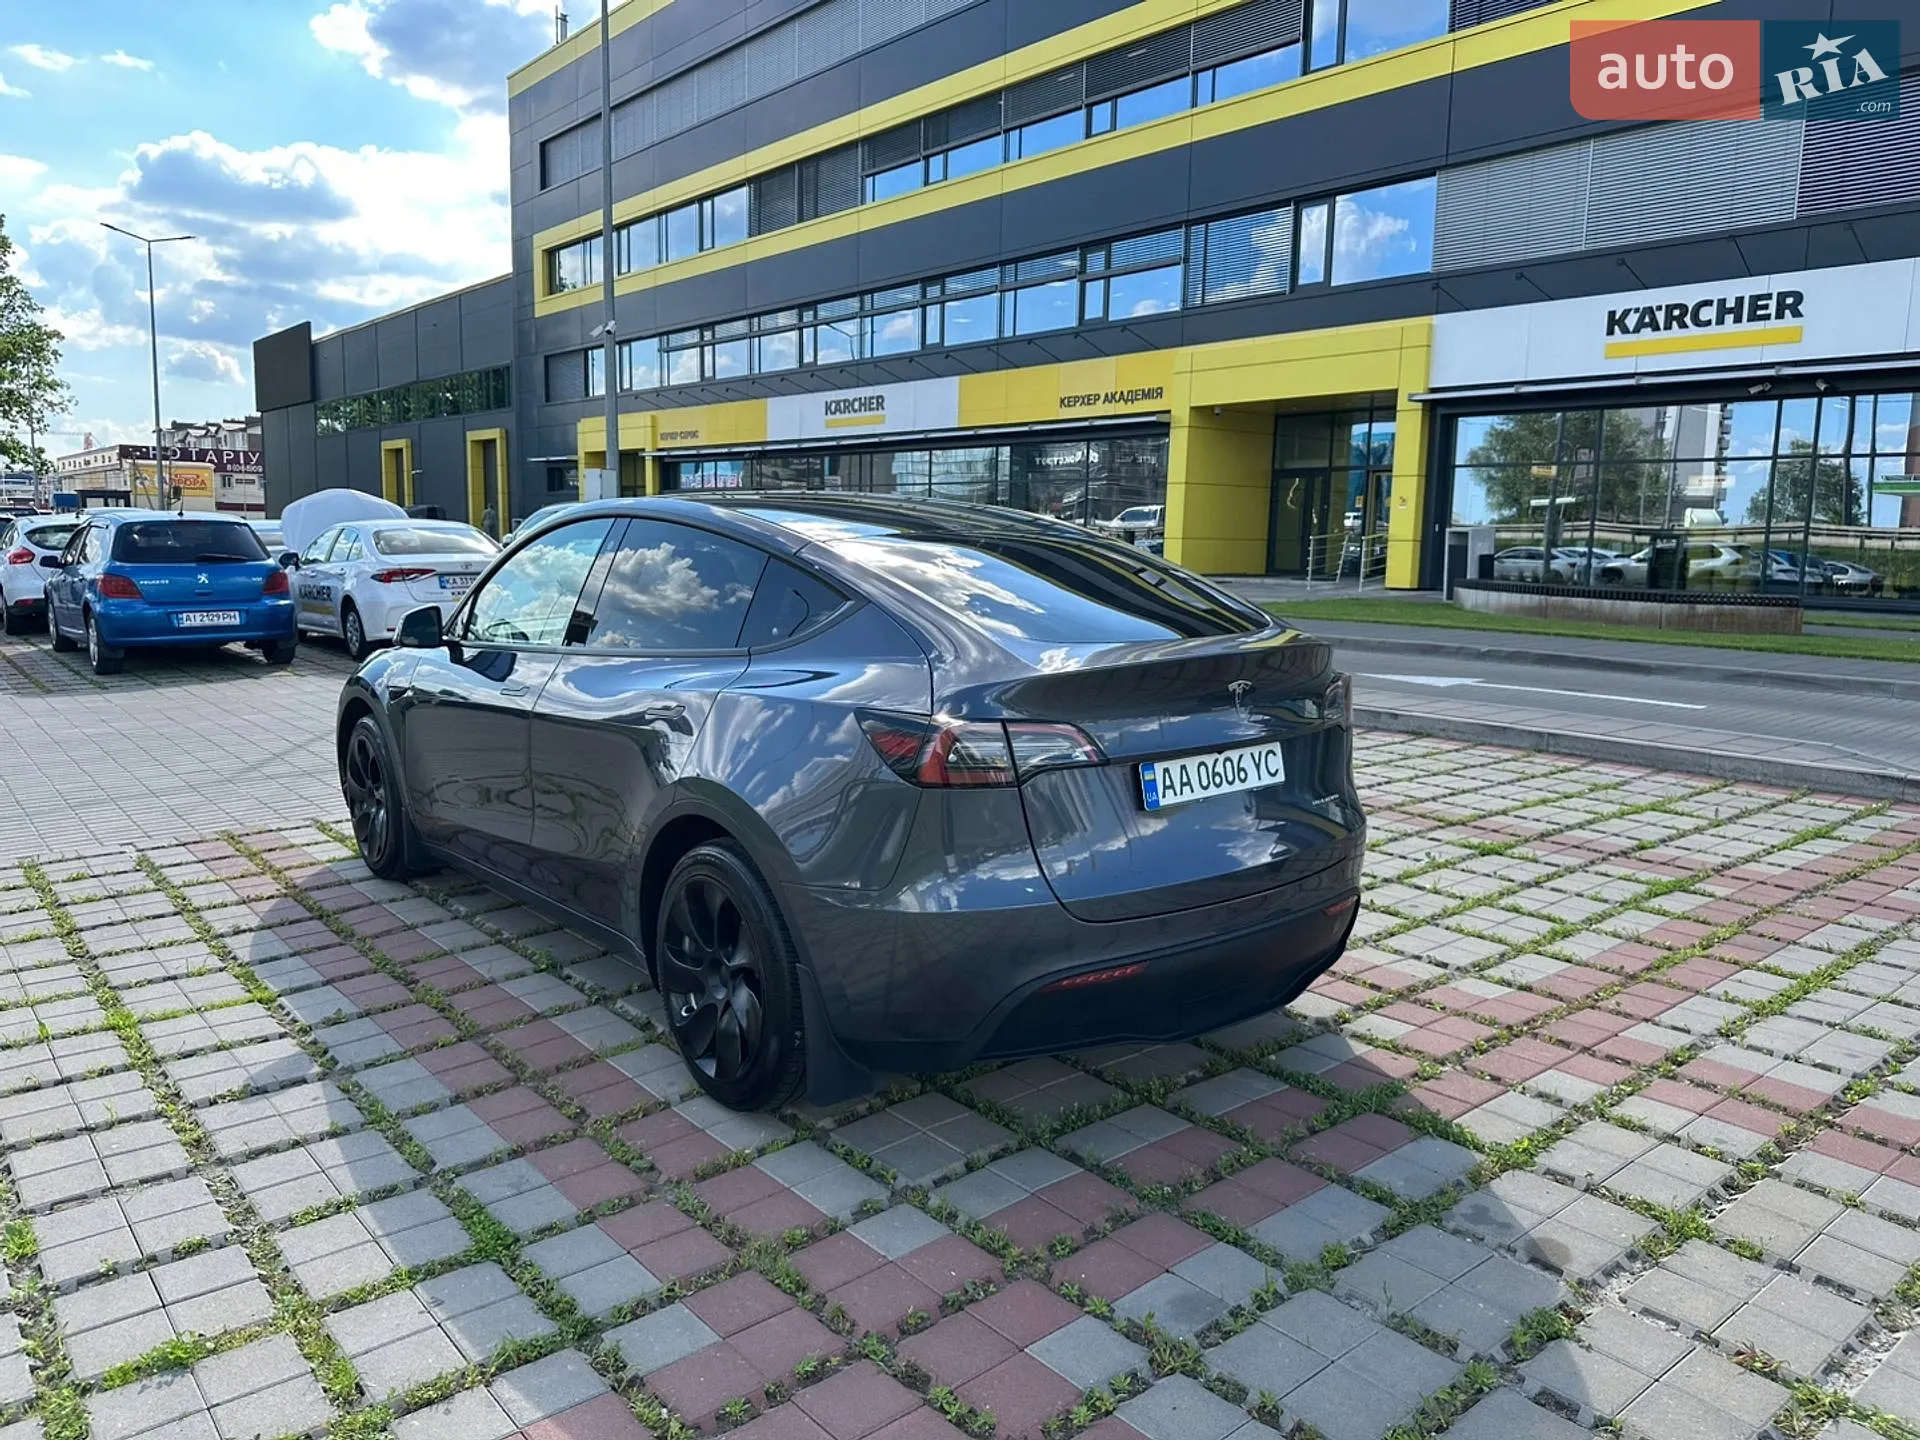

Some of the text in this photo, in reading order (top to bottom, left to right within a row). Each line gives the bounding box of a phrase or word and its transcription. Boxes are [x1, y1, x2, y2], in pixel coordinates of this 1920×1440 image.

[1605, 290, 1804, 336] KÄRCHER
[1060, 387, 1164, 408] КЕРХЕР АКАДЕМІЯ
[1162, 749, 1279, 799] AA 0606 YC
